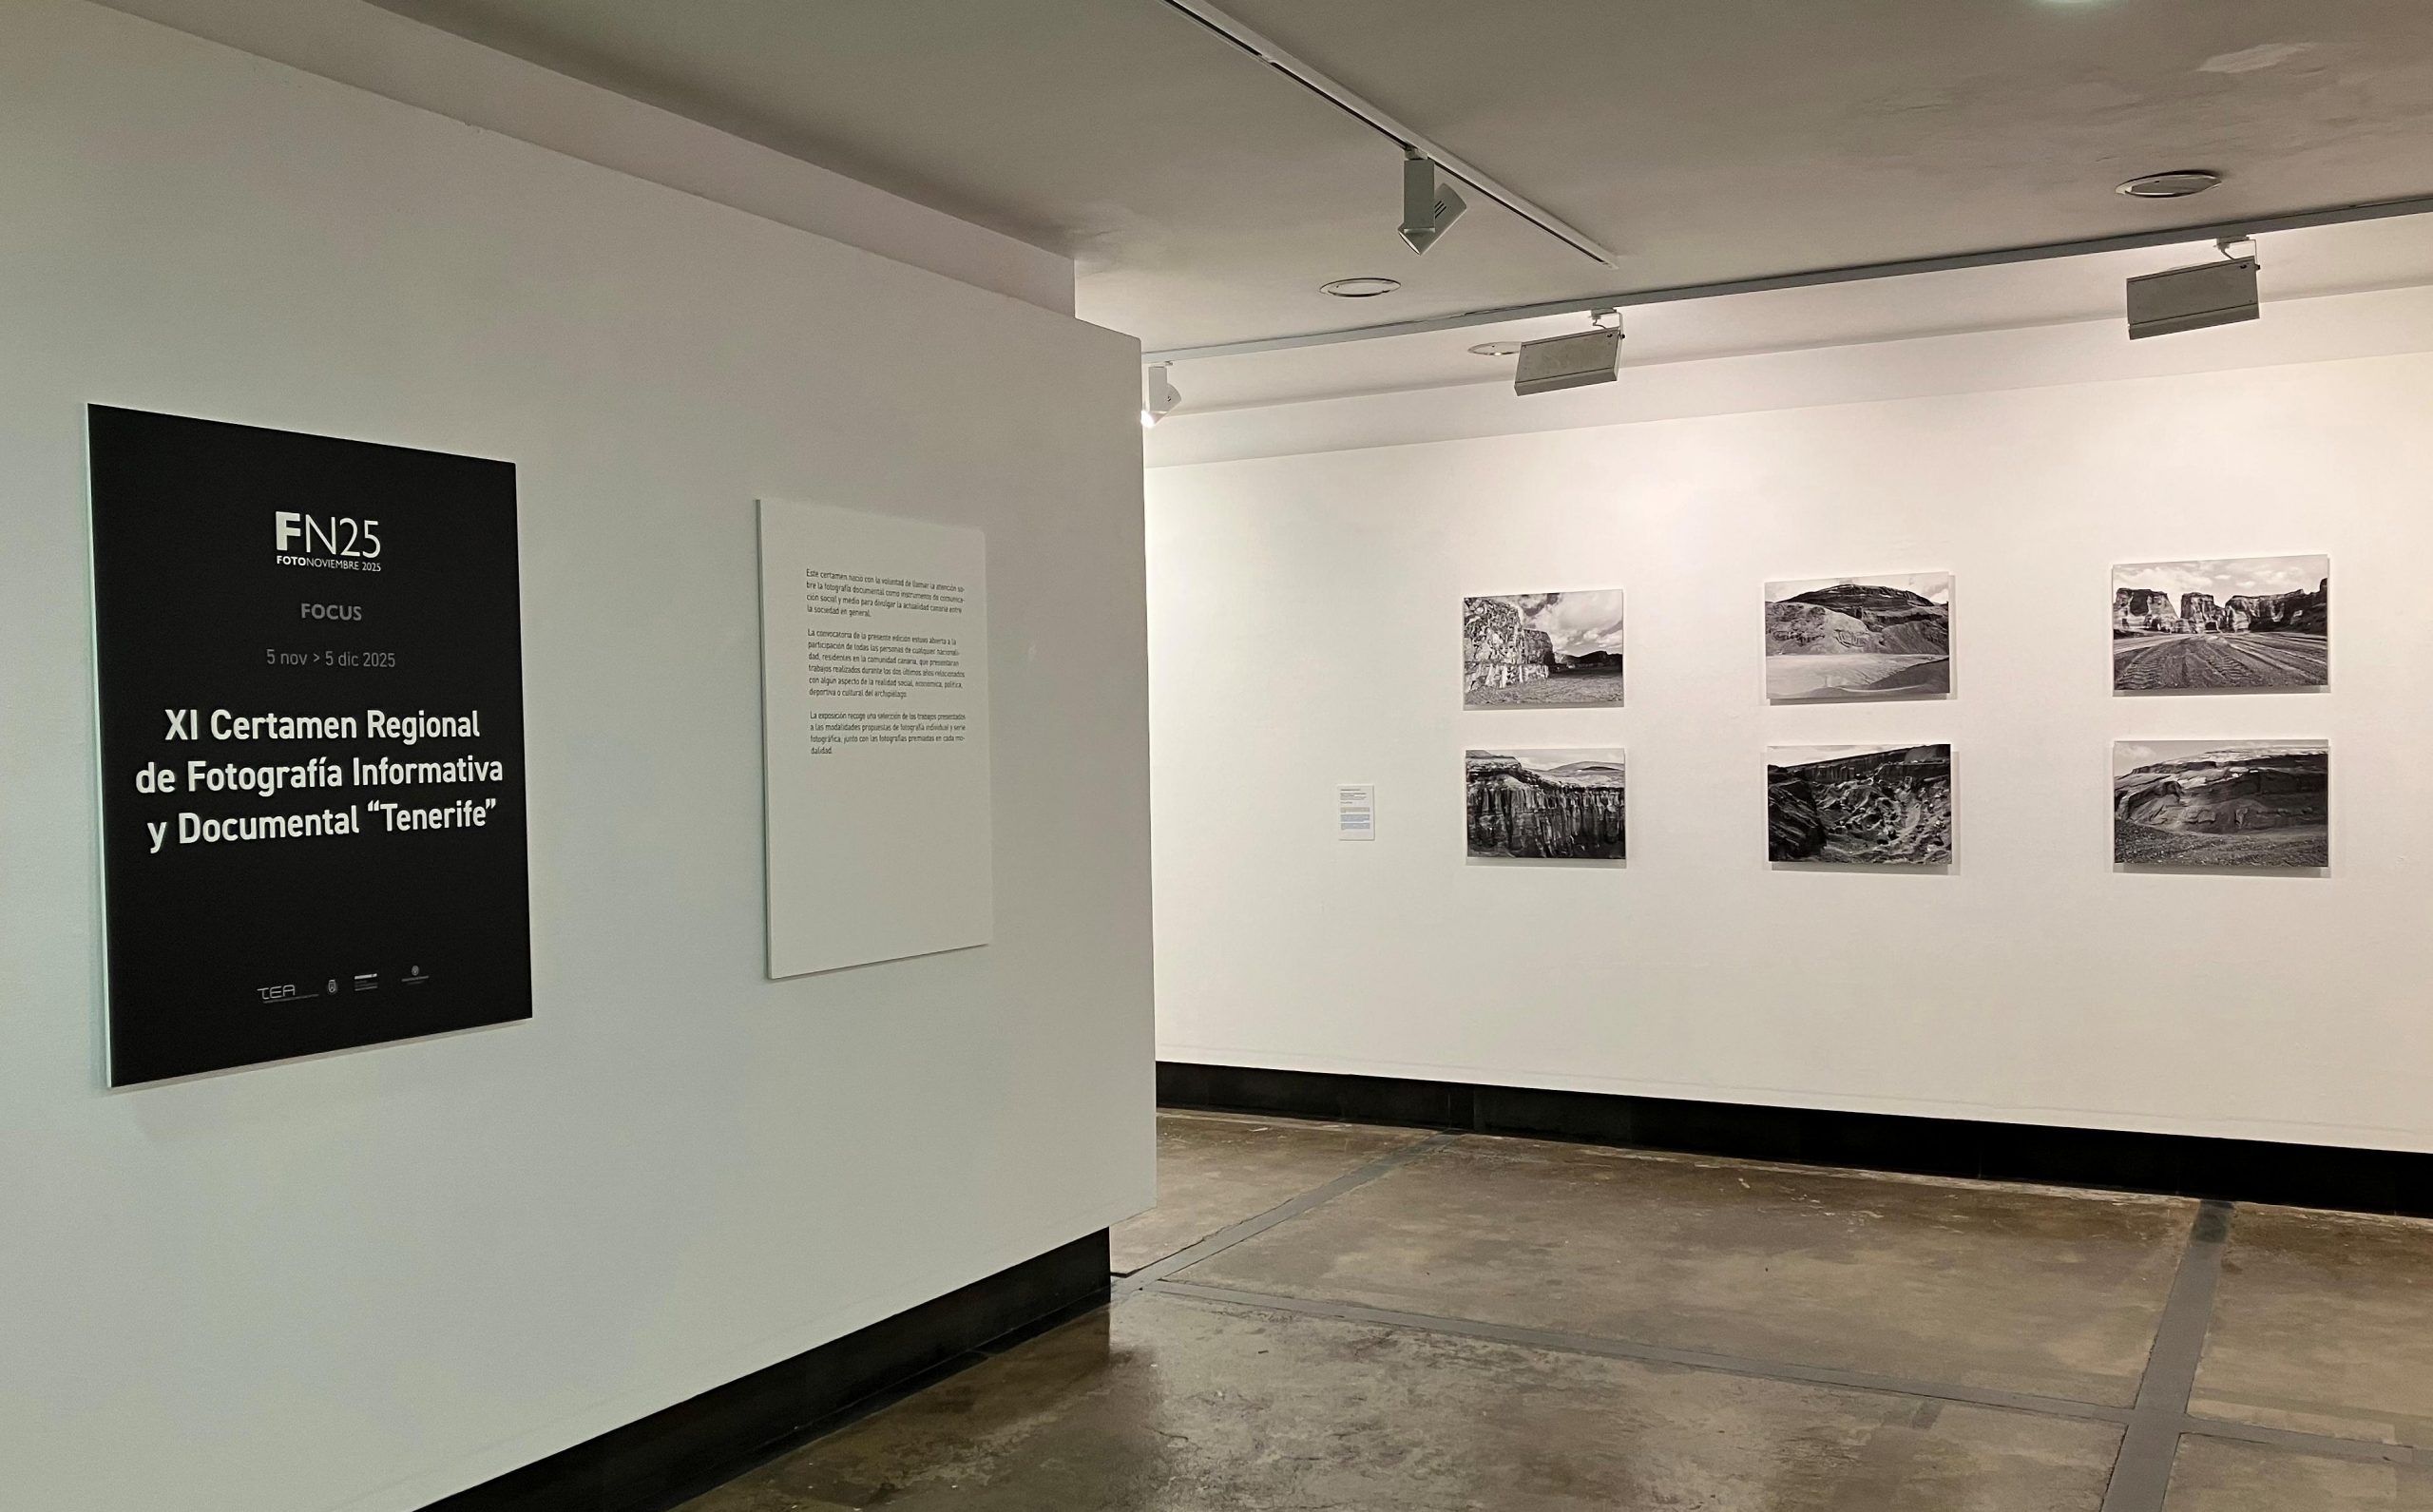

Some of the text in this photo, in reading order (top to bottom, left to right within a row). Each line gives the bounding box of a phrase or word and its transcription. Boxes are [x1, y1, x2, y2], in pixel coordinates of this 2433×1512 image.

[276, 511, 380, 558] FN25
[277, 556, 381, 571] FOTONOVIEMBRE 2025
[301, 603, 362, 621] FOCUS
[266, 649, 276, 664] 5
[280, 653, 308, 665] nov
[325, 651, 333, 665] 5
[338, 652, 359, 666] dic
[363, 653, 395, 667] 2025
[164, 709, 481, 745] XI Certamen Regional
[136, 755, 504, 797] de Fotografía Informativa
[146, 821, 168, 854] y
[178, 805, 360, 844] Documental
[257, 984, 296, 1000] TEA
